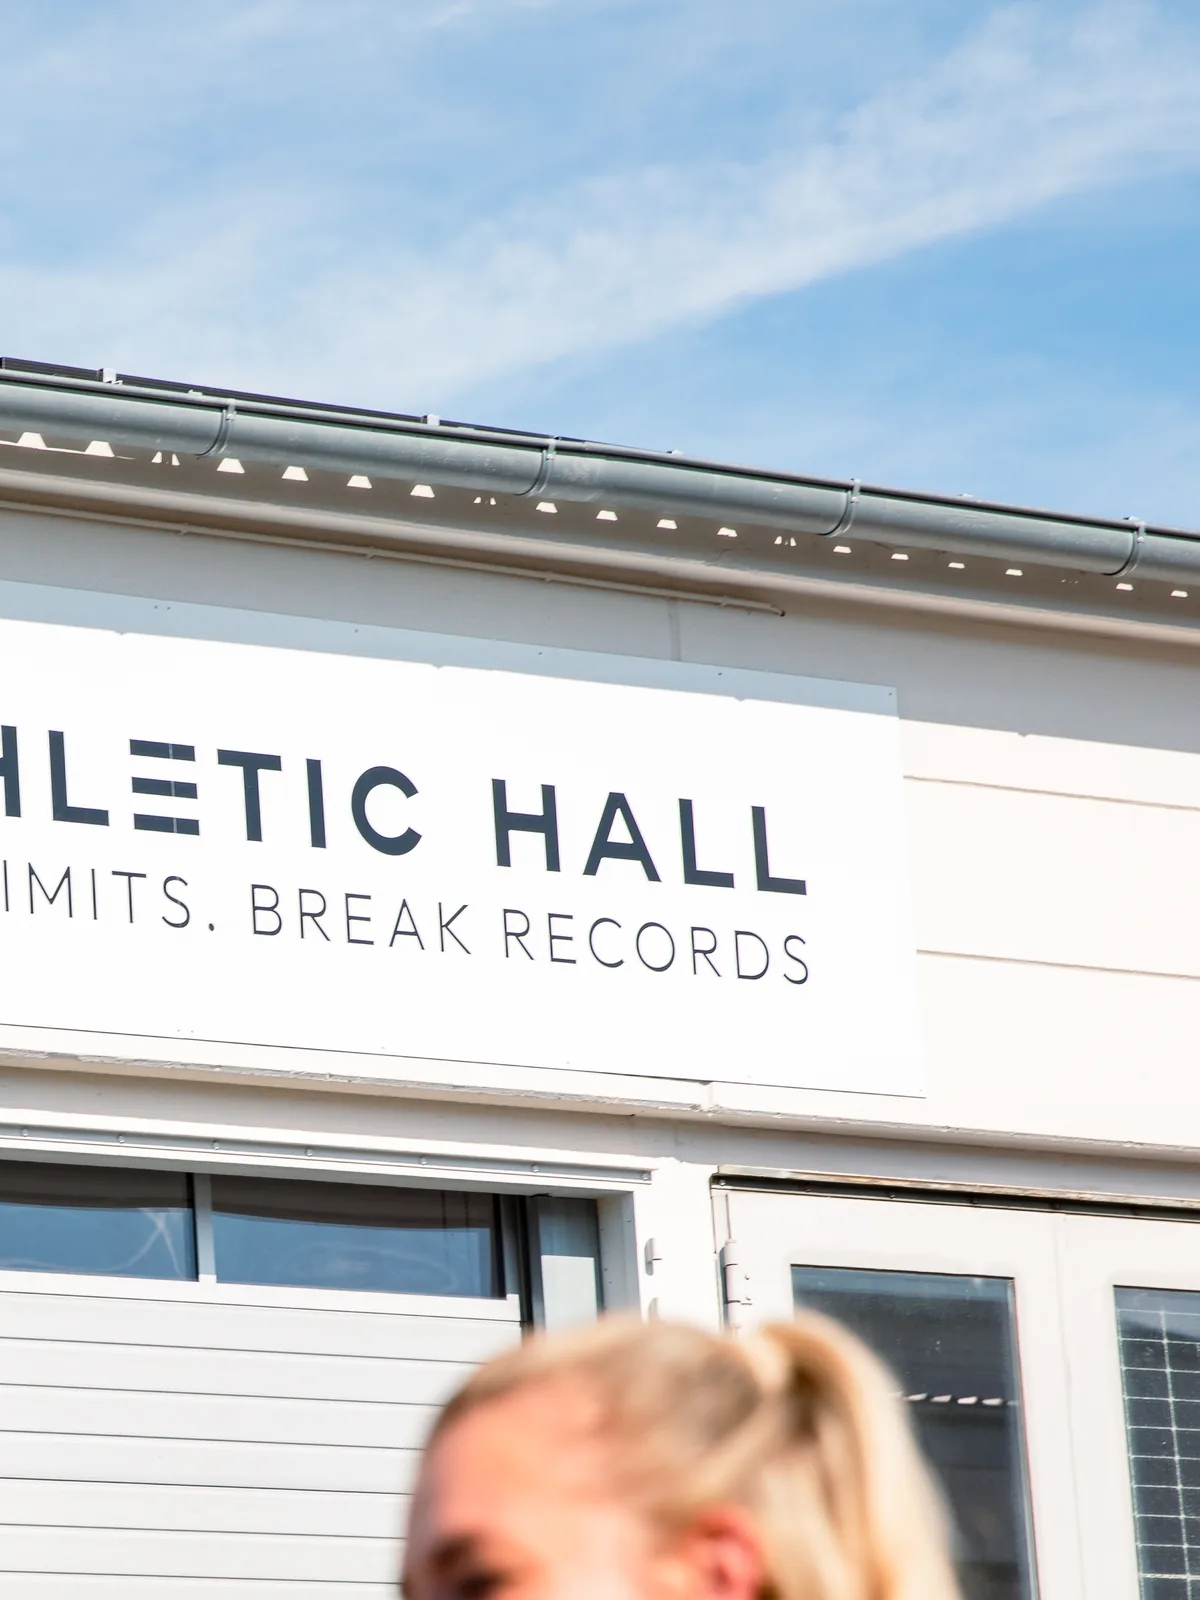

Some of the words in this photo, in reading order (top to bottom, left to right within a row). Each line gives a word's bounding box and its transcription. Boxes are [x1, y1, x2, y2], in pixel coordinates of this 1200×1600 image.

[491, 778, 808, 896] HALL
[250, 883, 472, 956] BREAK
[501, 908, 810, 986] RECORDS
